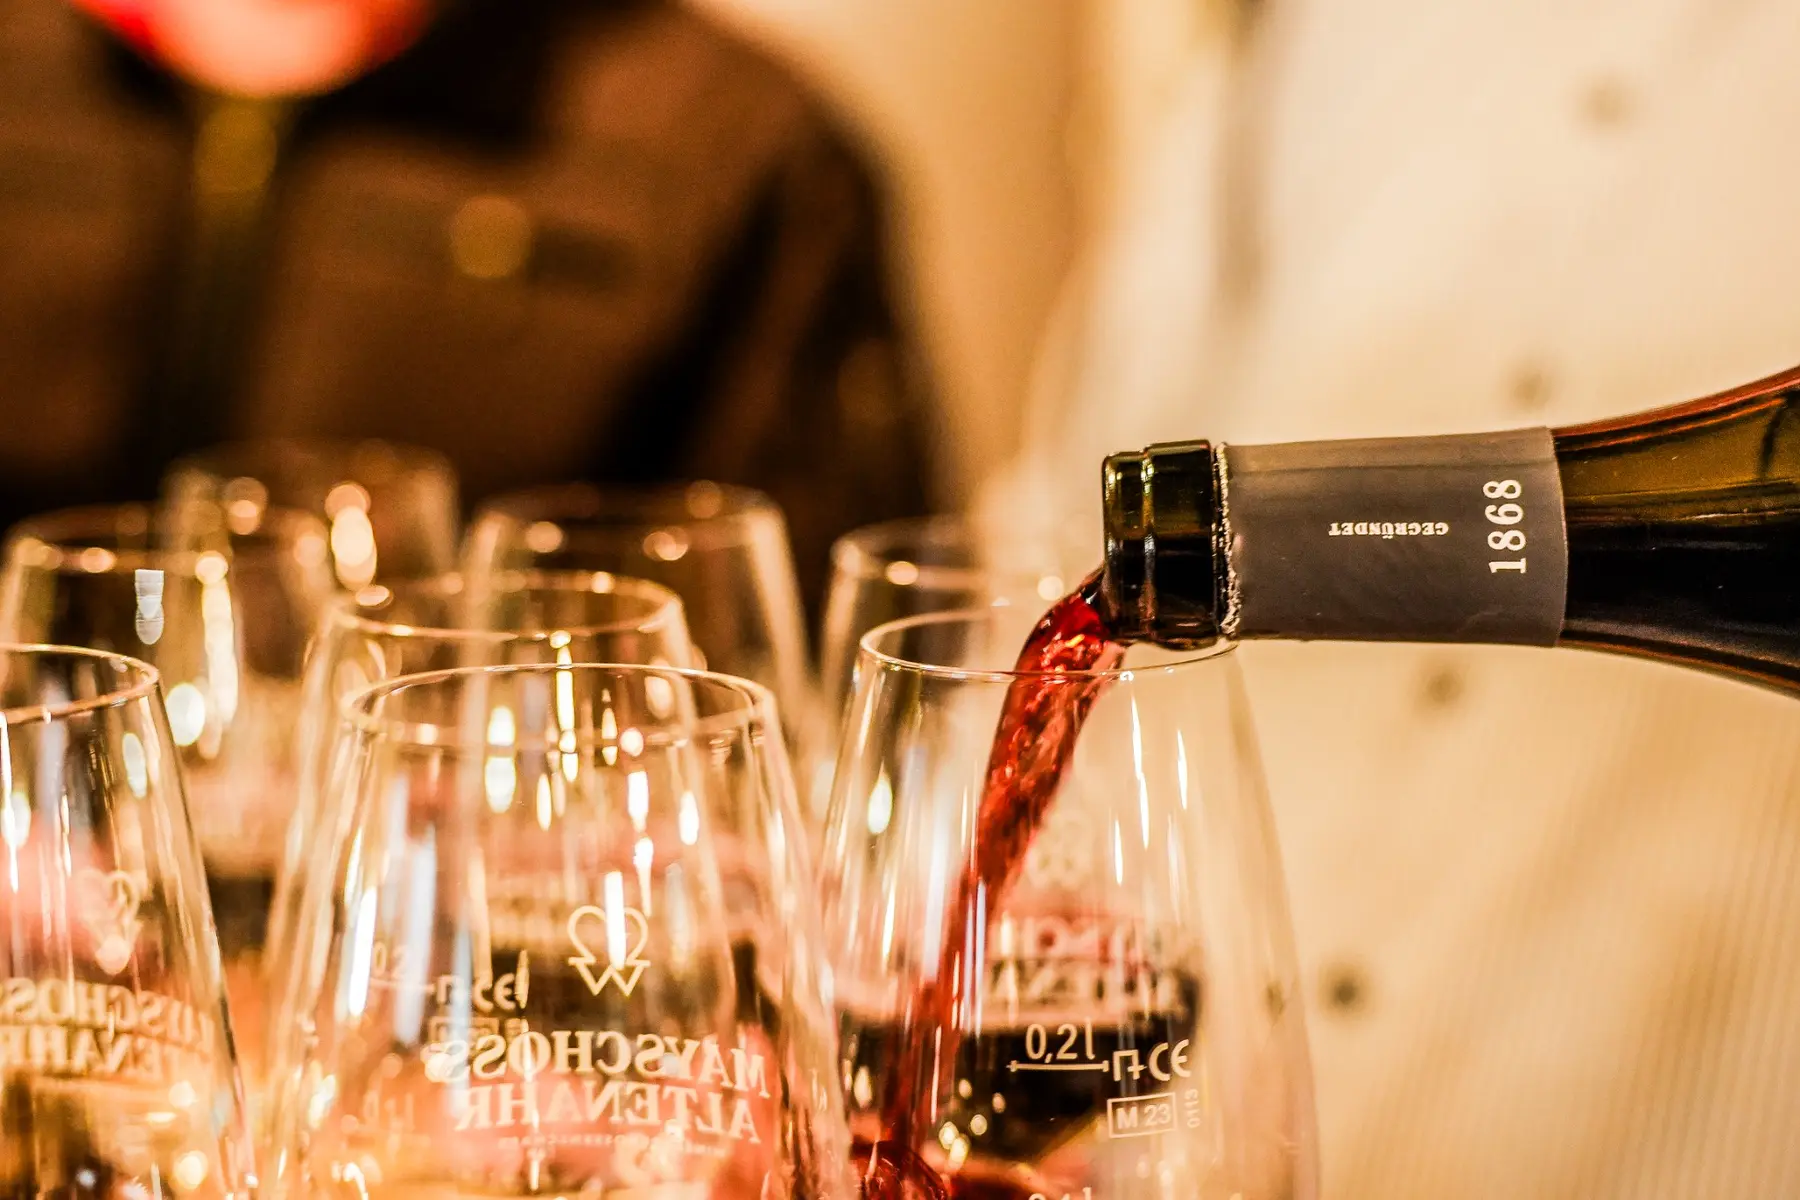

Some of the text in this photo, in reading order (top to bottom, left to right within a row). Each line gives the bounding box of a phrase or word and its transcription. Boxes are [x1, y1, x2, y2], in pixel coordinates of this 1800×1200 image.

[1328, 522, 1450, 539] GEGRÜNDET
[1482, 479, 1527, 574] 1868
[1117, 1103, 1172, 1130] M 23
